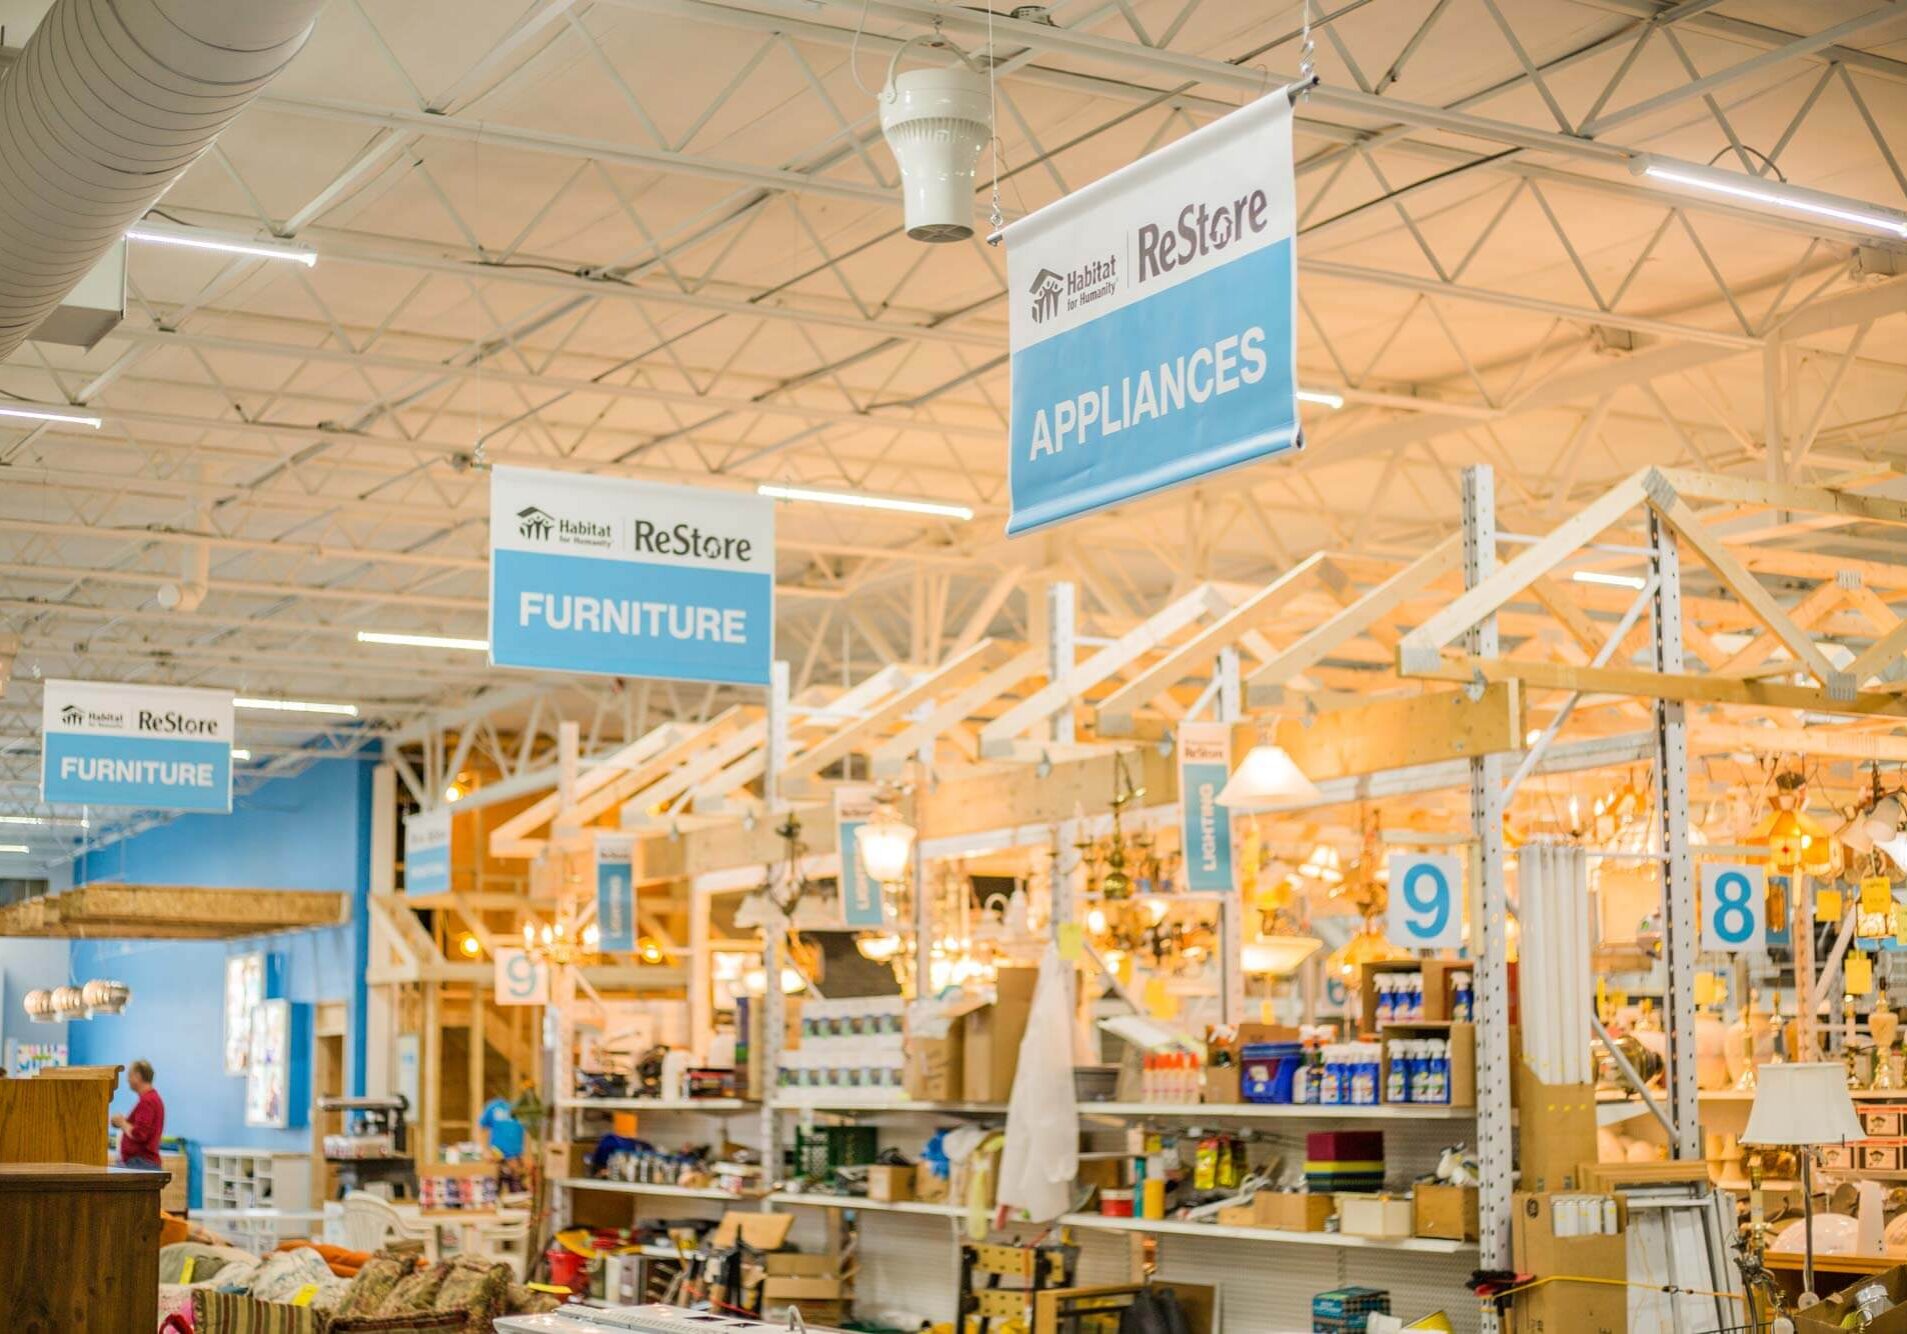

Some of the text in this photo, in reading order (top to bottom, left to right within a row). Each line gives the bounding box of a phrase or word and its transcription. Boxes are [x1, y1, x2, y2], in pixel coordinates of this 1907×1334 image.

[1137, 188, 1268, 284] ReStore
[1067, 254, 1117, 297] Habitat
[1067, 281, 1117, 312] for Humanity
[1029, 325, 1268, 463] APPLIANCES
[559, 518, 612, 538] Habitat
[634, 519, 752, 562] ReStore
[519, 591, 748, 645] FURNITURE
[138, 710, 218, 736] ReStore
[60, 756, 214, 788] FURNITURE
[1199, 782, 1217, 872] LIGHTING
[1402, 862, 1451, 940] 9
[1712, 871, 1755, 944] 8
[506, 954, 537, 998] 9
